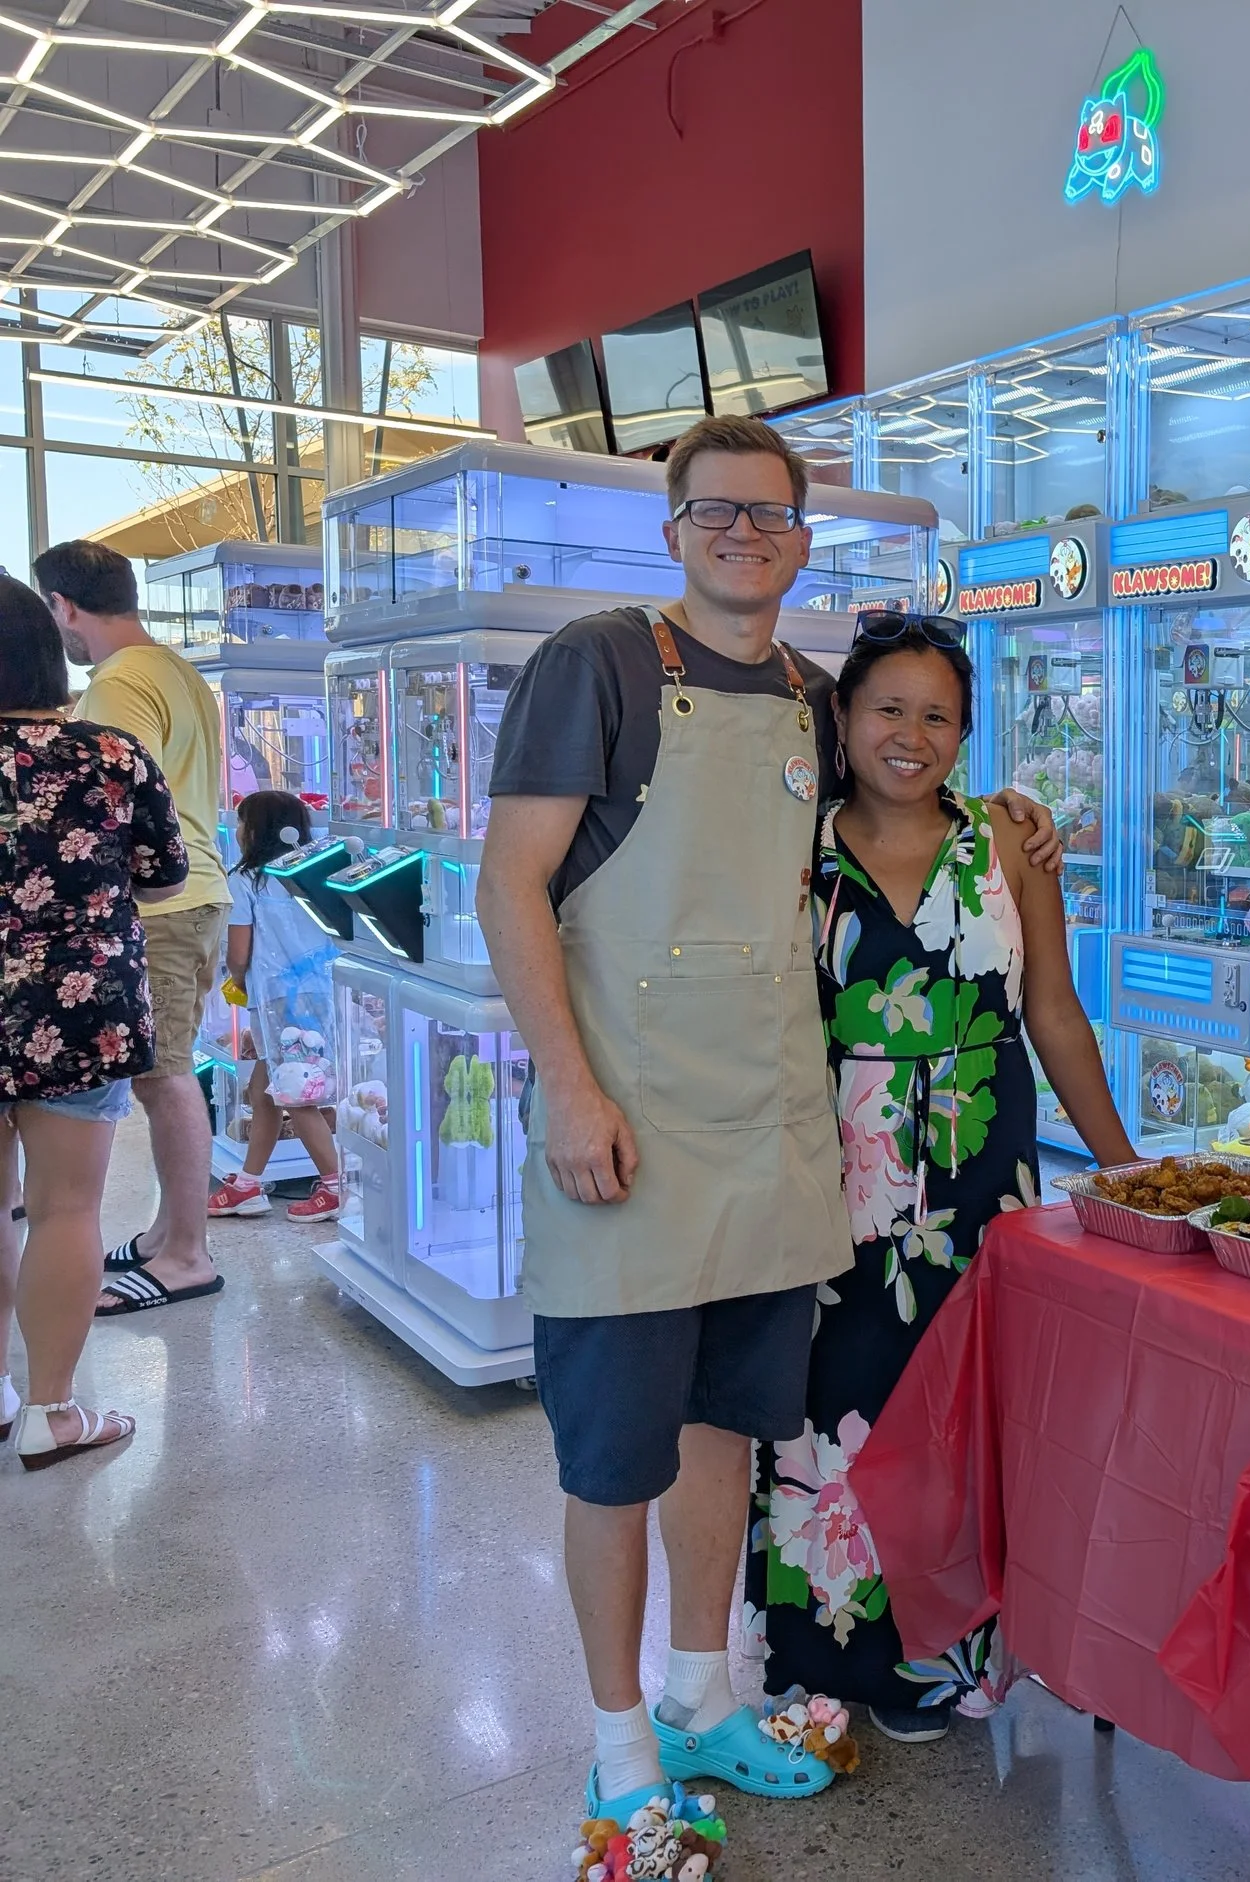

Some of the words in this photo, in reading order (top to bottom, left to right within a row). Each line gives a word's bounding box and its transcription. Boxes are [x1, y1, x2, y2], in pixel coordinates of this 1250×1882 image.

[763, 281, 799, 306] PLAY!
[1113, 561, 1211, 596] KLAWSOME!
[960, 581, 1037, 613] KLAWSOME!
